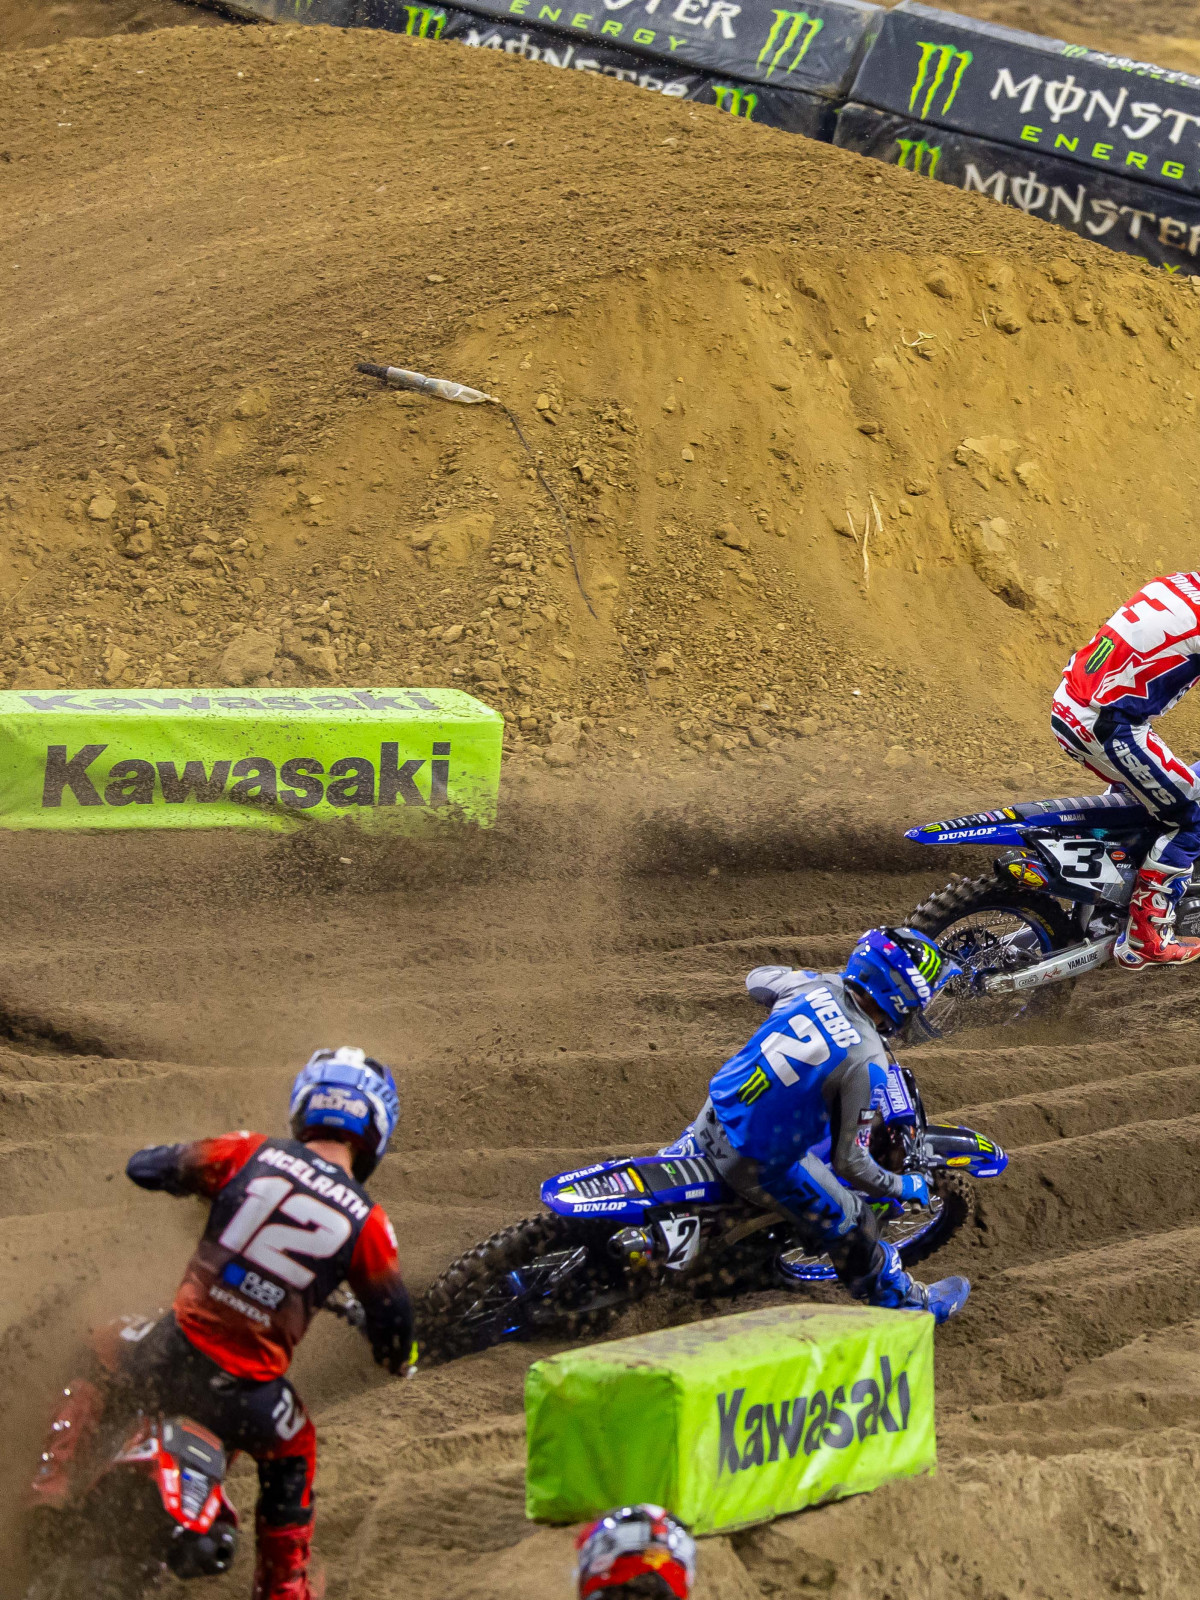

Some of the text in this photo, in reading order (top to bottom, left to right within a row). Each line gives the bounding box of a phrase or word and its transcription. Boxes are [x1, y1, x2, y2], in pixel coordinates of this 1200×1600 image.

[508, 0, 688, 51] ENERGY
[1105, 581, 1198, 655] 3
[18, 691, 443, 711] Kawasaki
[41, 741, 452, 810] Kawasaki
[937, 826, 997, 842] DUNLOP
[1058, 813, 1086, 822] YAMAHA
[1061, 840, 1106, 879] 3
[1066, 952, 1099, 970] YAMALUBE
[804, 986, 862, 1049] WEBB
[889, 994, 910, 1014] FLY
[760, 1013, 831, 1088] 2
[699, 1126, 728, 1161] FLY
[257, 1147, 370, 1221] MCELRATH
[557, 1162, 605, 1185] DUNLOP
[685, 1187, 706, 1200] YAMAHA
[572, 1201, 628, 1214] DUNLOP
[217, 1175, 353, 1291] 12
[665, 1219, 698, 1264] 2
[209, 1284, 272, 1329] HONDA
[715, 1349, 912, 1477] Kawasaki
